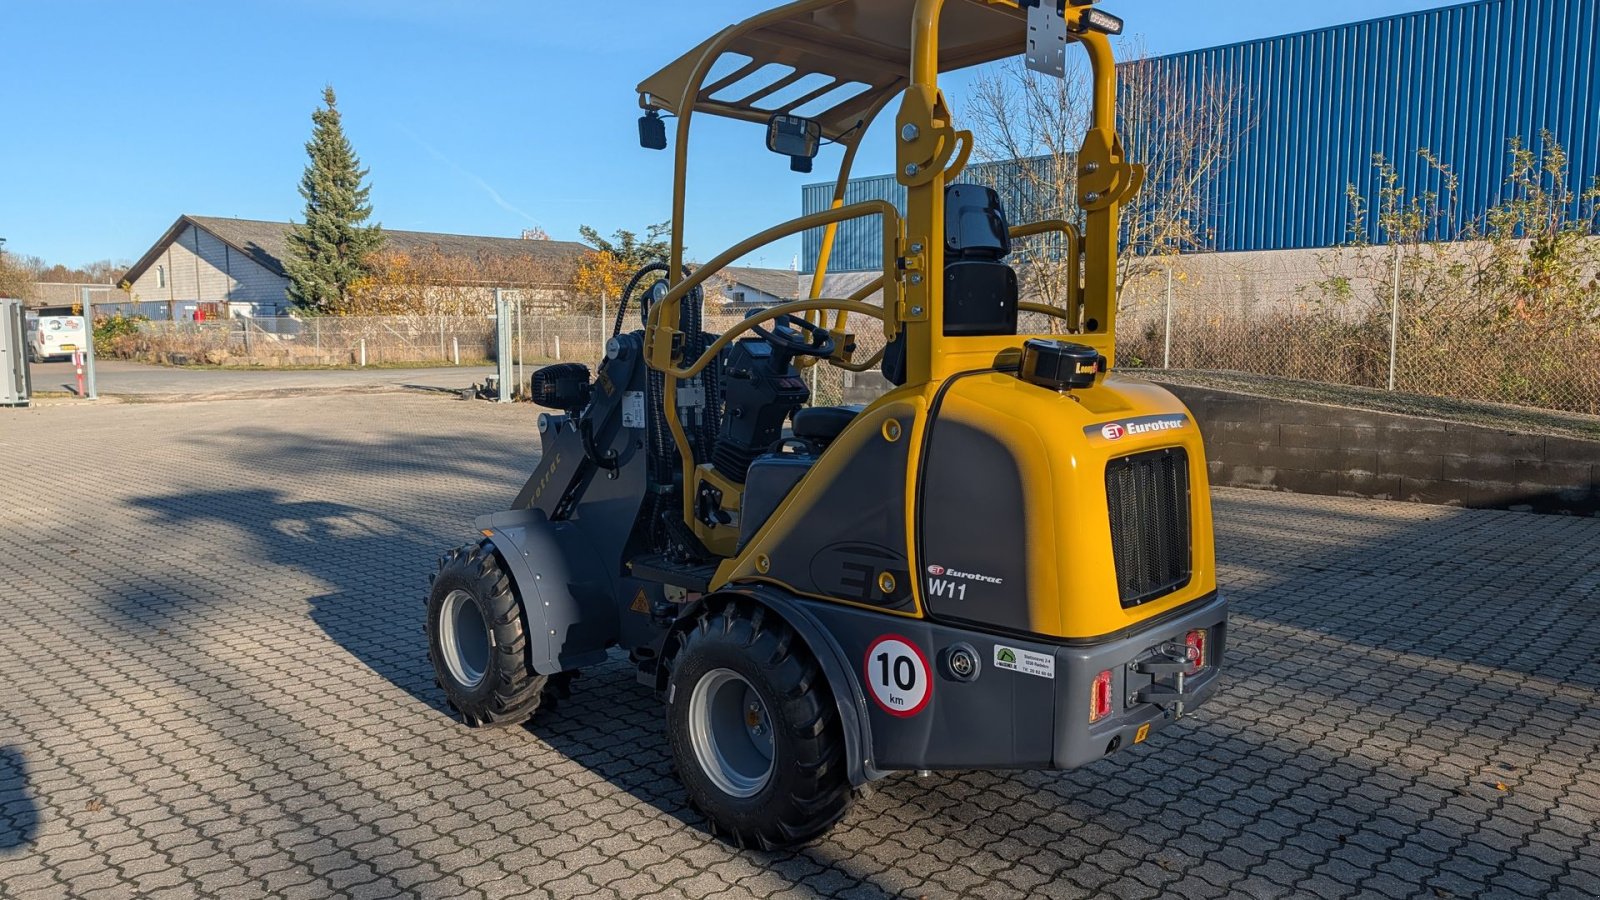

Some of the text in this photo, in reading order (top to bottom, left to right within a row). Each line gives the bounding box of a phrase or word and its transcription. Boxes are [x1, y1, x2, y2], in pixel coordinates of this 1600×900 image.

[1105, 420, 1183, 439] ET Eurotrac
[946, 568, 1003, 584] Eurotrac
[928, 577, 966, 600] W11
[877, 652, 916, 691] 10
[889, 693, 904, 705] km
